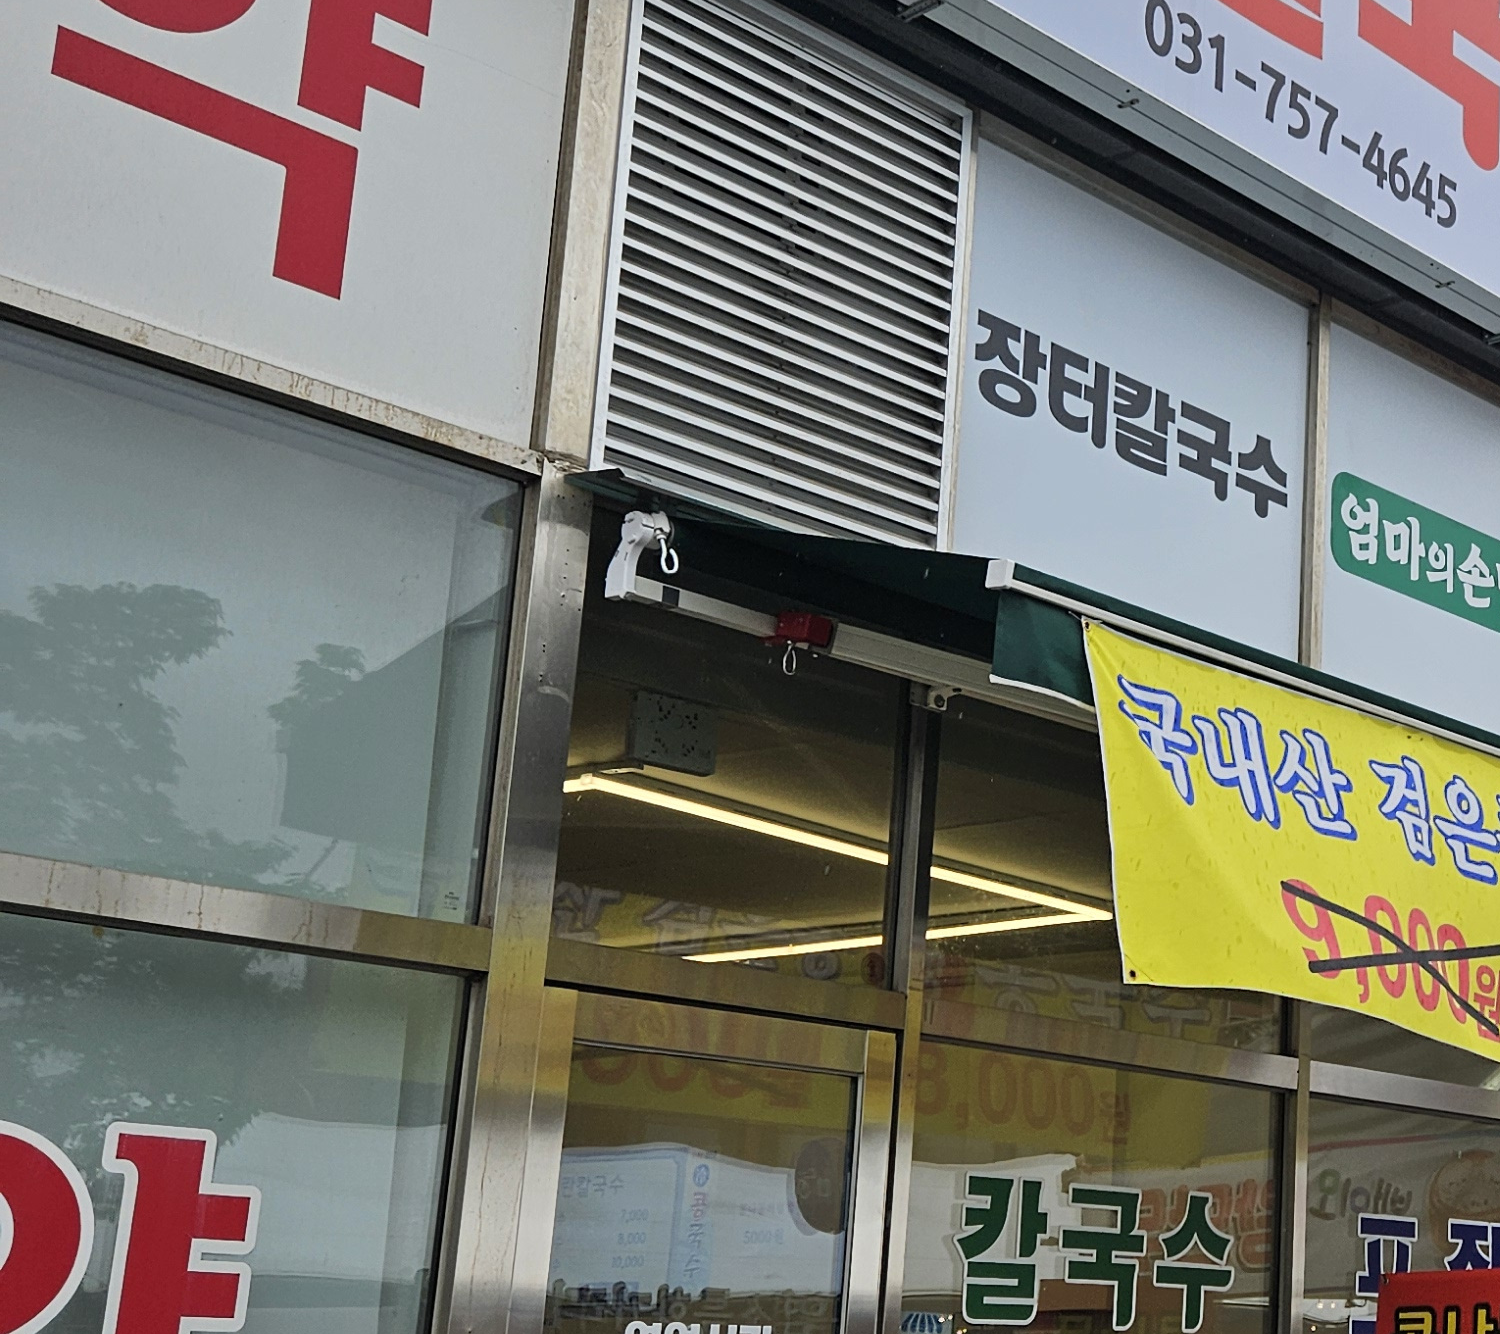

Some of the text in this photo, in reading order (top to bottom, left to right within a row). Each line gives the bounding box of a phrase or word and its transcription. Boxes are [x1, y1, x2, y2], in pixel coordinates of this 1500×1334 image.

[975, 309, 1288, 518] 장터칼국수
[1117, 672, 1358, 841] 국내산
[953, 1170, 1235, 1334] 칼국수
